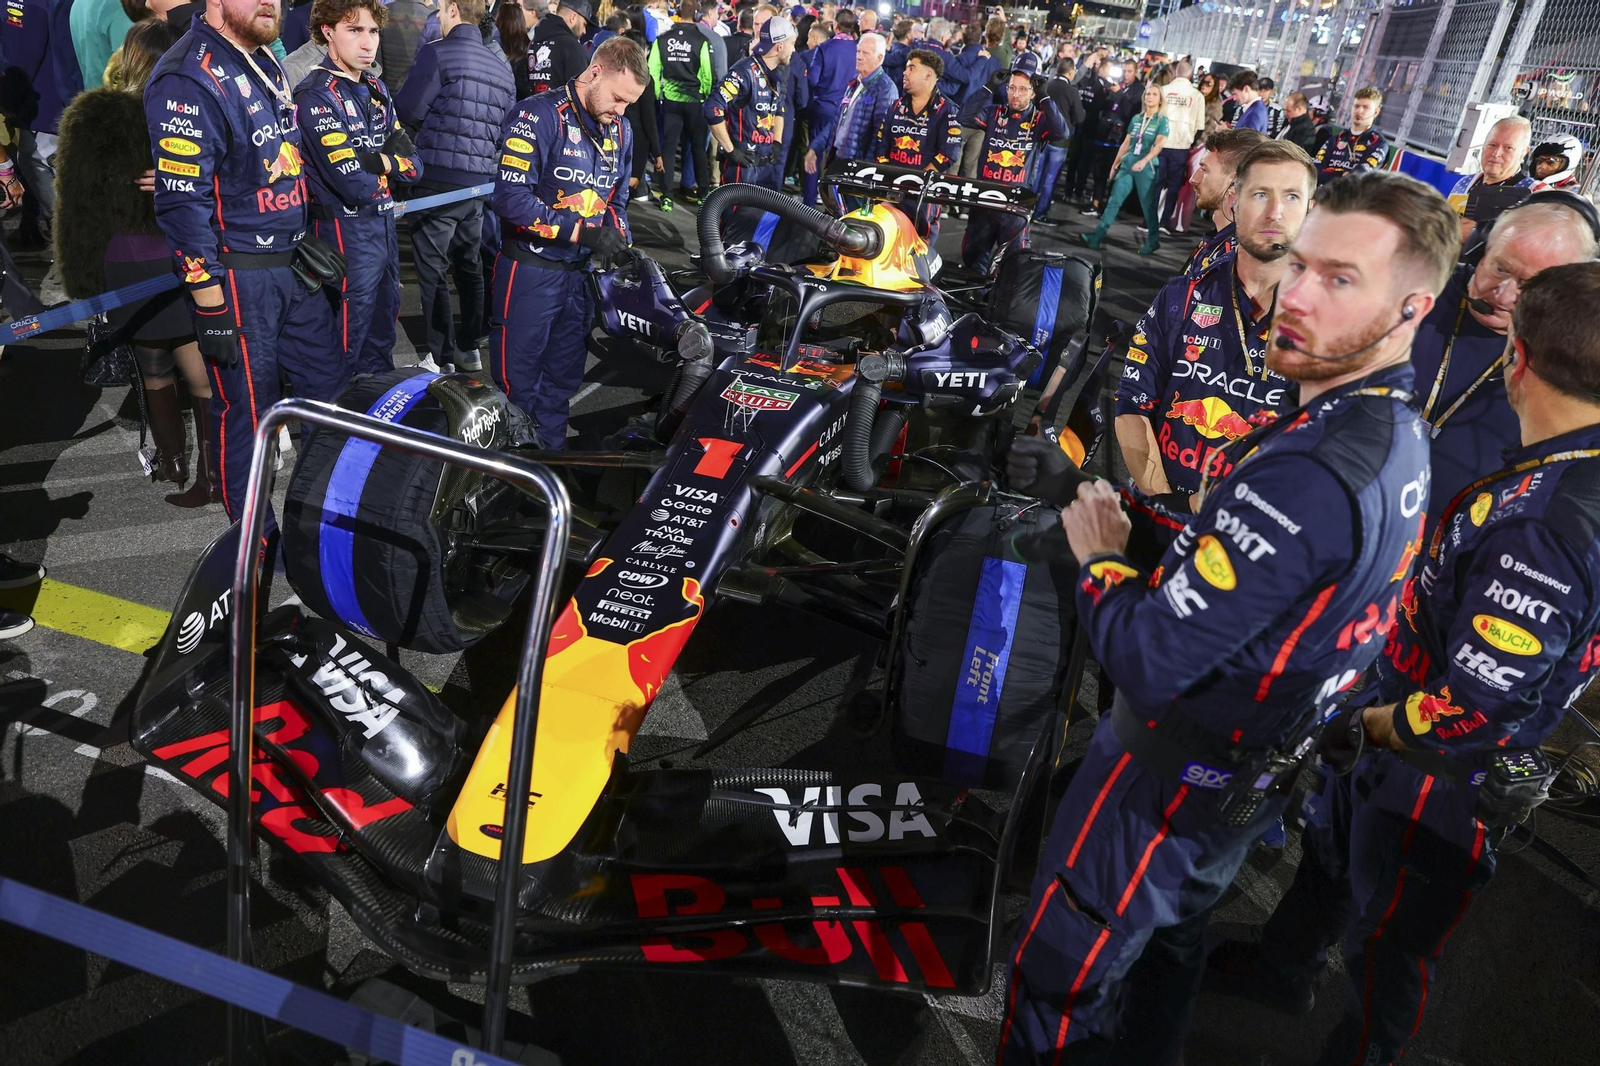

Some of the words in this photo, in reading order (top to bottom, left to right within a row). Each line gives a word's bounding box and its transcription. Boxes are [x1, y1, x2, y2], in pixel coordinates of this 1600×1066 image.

[7, 1, 24, 9] ROKT
[667, 38, 692, 52] Stake
[166, 100, 199, 116] Mobil
[519, 110, 540, 124] Mobil
[169, 116, 194, 129] AVA
[314, 122, 342, 133] TRADE
[318, 116, 336, 124] AVA
[515, 121, 533, 131] AVA
[160, 123, 203, 138] TRADE
[251, 117, 299, 147] ORACL
[510, 126, 537, 140] TRADE
[890, 125, 929, 137] ORACLE
[169, 140, 196, 154] RAUCH
[563, 147, 581, 157] Mobil
[988, 136, 1034, 151] ORACLE
[161, 160, 197, 174] PIRELLI
[336, 159, 361, 175] VISA
[900, 150, 922, 166] Bull
[500, 169, 526, 184] VISA
[553, 166, 620, 189] ORACLE
[982, 164, 1003, 180] Red
[1002, 168, 1027, 183] Bull
[161, 177, 196, 193] VISA
[1196, 304, 1222, 316] TAG
[10, 316, 39, 330] ORACLE
[617, 308, 653, 337] YETI
[1191, 312, 1220, 328] HEUER
[934, 371, 986, 389] YETI
[1171, 359, 1286, 406] ORACLE
[725, 390, 790, 408] HEUER
[737, 384, 793, 401] TAG
[372, 389, 406, 419] Front
[381, 393, 414, 424] Right
[481, 405, 502, 432] Rock
[818, 411, 849, 448] CARLY
[1158, 420, 1204, 472] Red
[673, 483, 719, 504] VISA
[669, 514, 708, 529] AT&T
[644, 528, 695, 546] TRADE
[656, 525, 686, 537] AVA
[1214, 507, 1278, 563] ROKT
[631, 540, 660, 552] Maui
[655, 544, 688, 560] Jim
[625, 556, 678, 574] CARLYLE
[617, 569, 657, 586] CDW
[1513, 560, 1572, 595] 1Password
[605, 587, 656, 607] neat.
[1483, 578, 1561, 625] ROKT
[208, 588, 232, 630] AT
[596, 598, 653, 620] PIRELLI
[588, 611, 630, 631] Mobil
[628, 621, 646, 634] 1
[1487, 622, 1534, 652] RAUCH
[965, 644, 987, 688] Left
[1454, 642, 1526, 688] HRC
[976, 651, 1001, 705] Front
[1459, 709, 1489, 735] Bull
[753, 781, 938, 847] VISA
[629, 865, 957, 989] Bull
